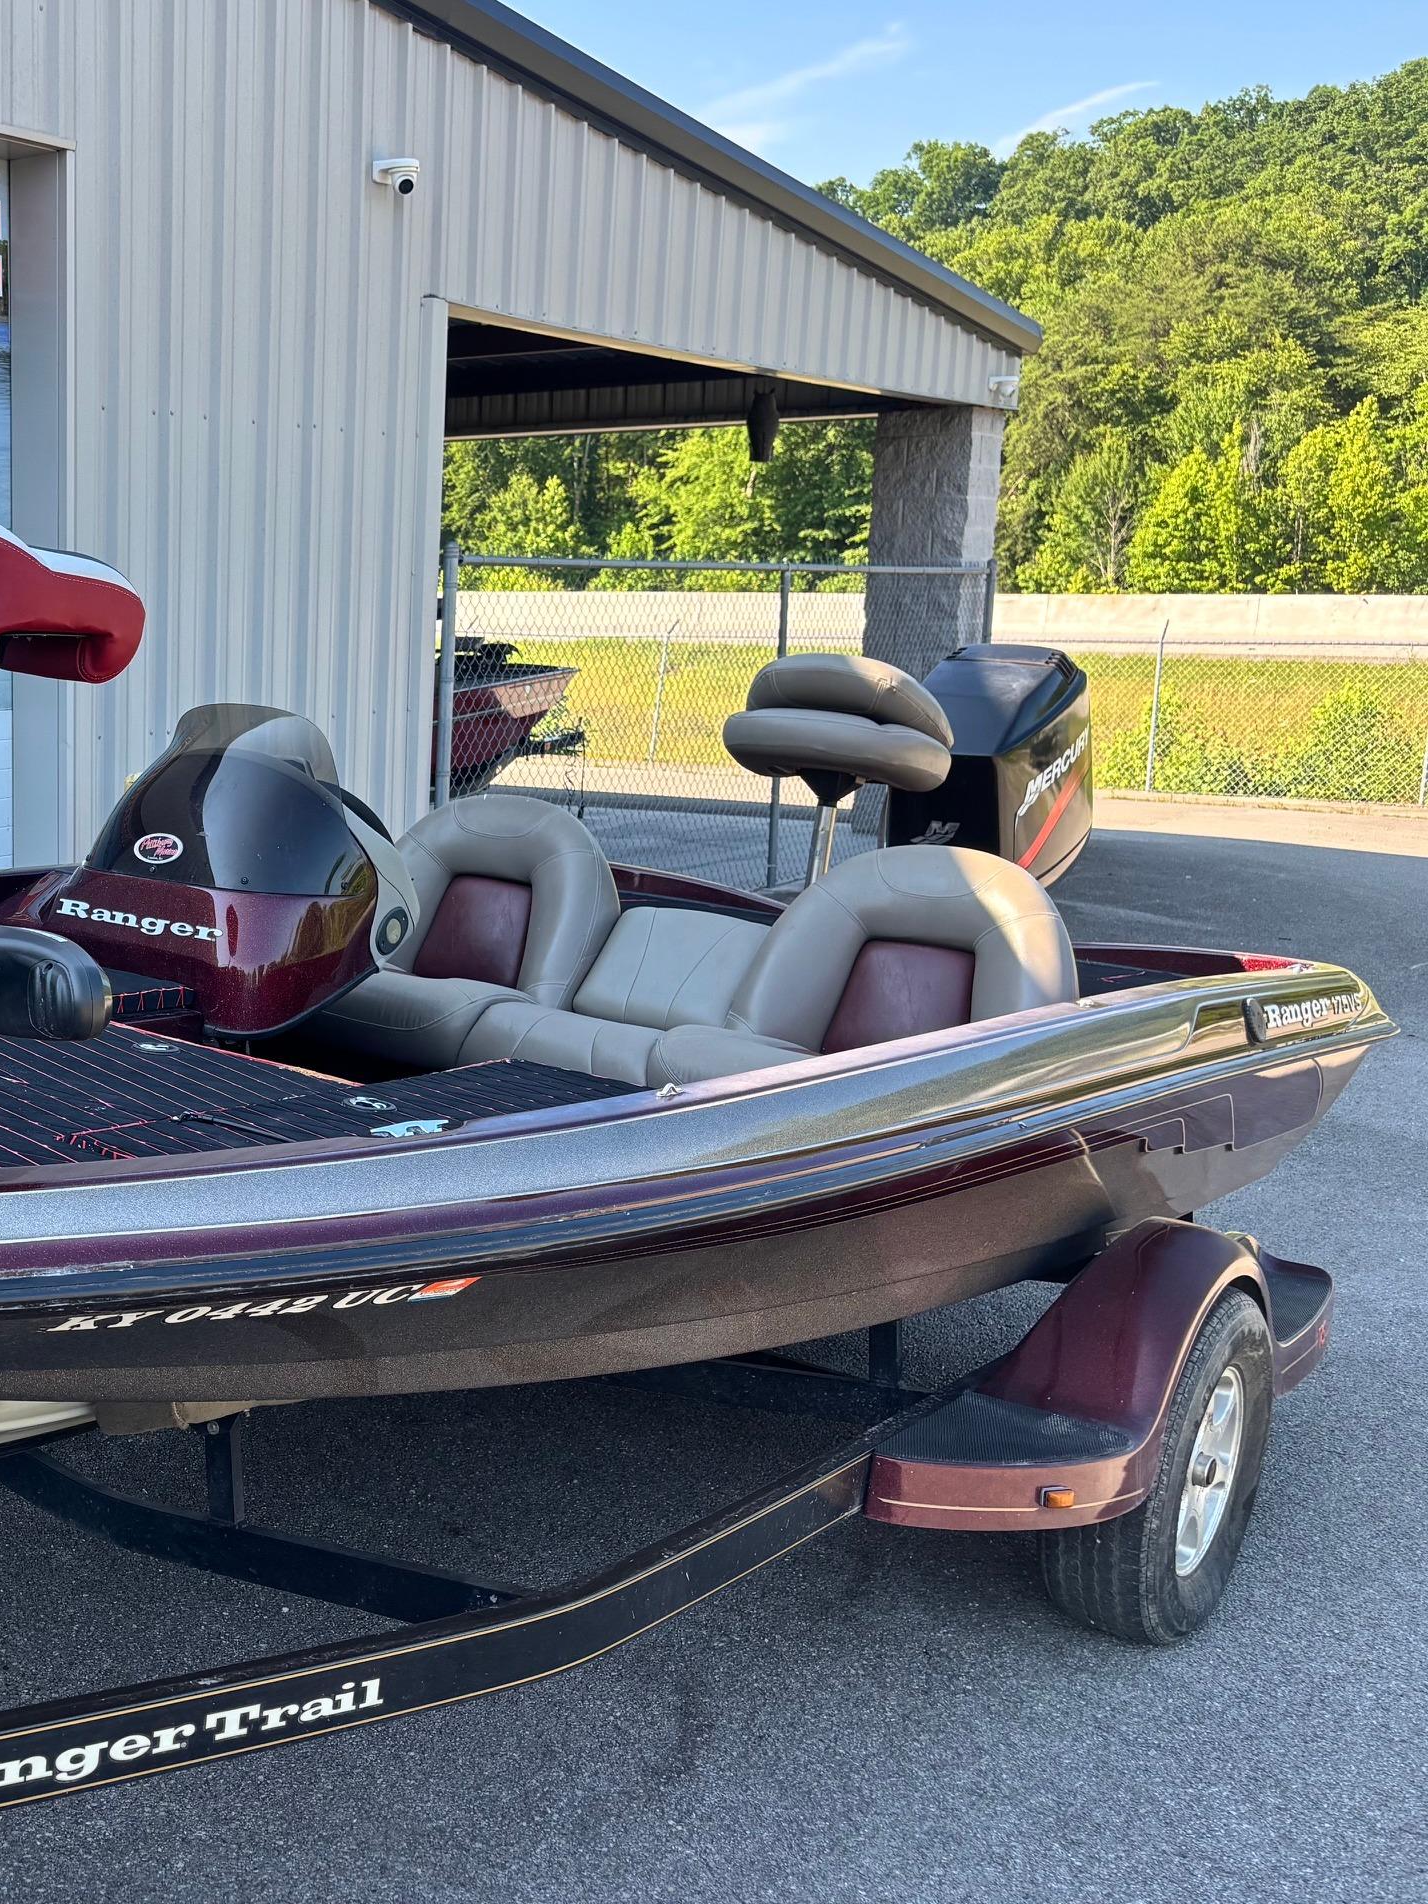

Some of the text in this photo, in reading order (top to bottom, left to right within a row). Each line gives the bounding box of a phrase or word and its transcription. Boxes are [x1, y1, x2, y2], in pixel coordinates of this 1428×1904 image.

[1022, 722, 1090, 806] MERCURY
[56, 898, 223, 941] Ranger
[1263, 997, 1332, 1028] Ranger
[46, 1283, 428, 1332] KY 0442 UC
[204, 1678, 384, 1744] Trail
